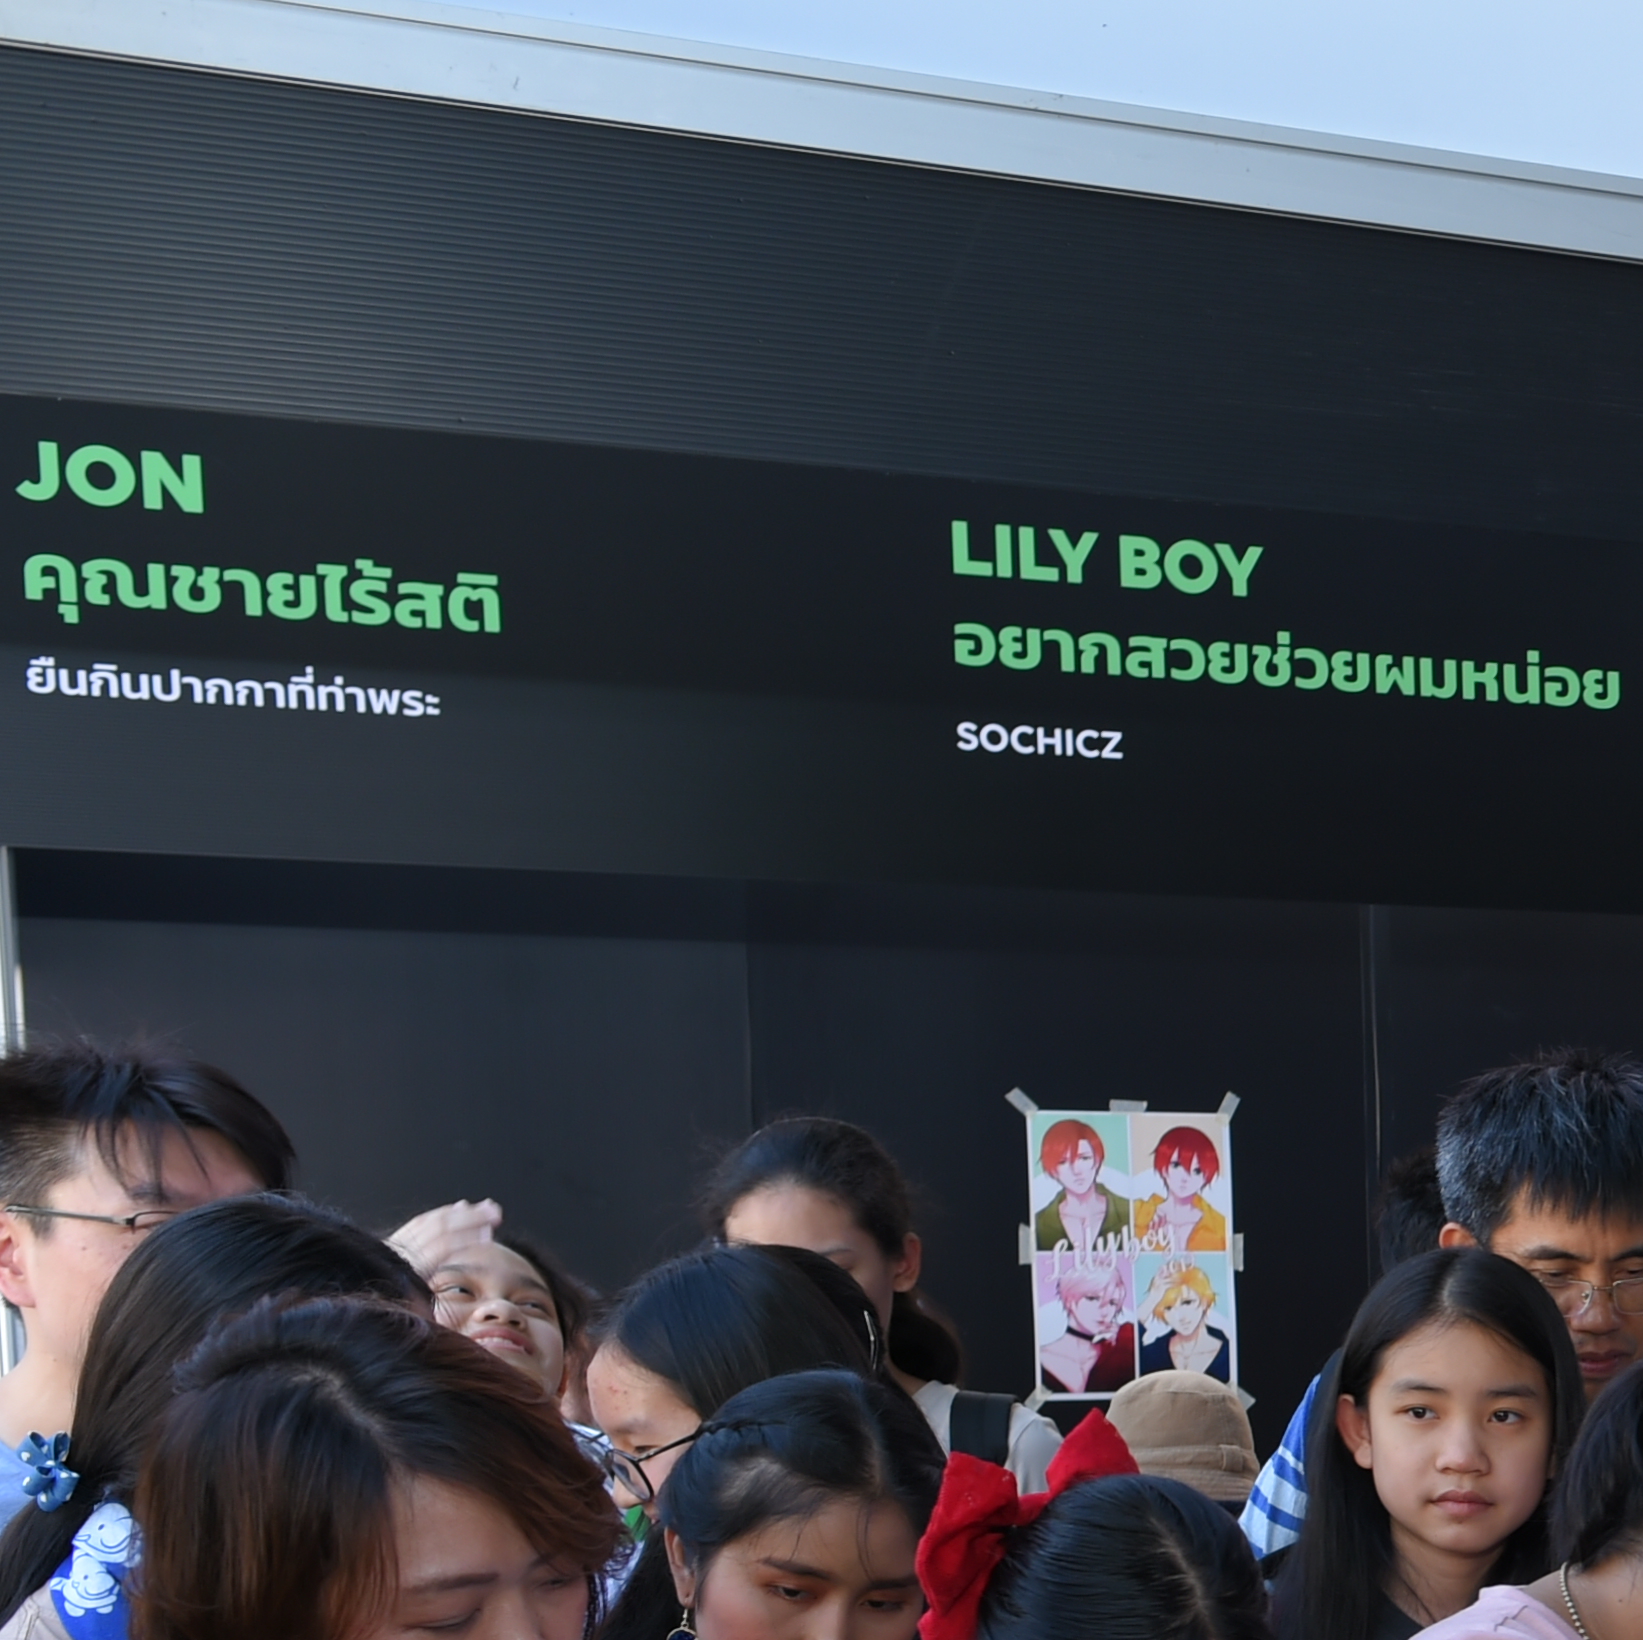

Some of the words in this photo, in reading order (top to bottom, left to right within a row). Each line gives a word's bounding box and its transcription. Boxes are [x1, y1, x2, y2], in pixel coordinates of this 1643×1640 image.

[16, 439, 207, 515] JON
[23, 552, 504, 635] คุณชายไร้สติ
[951, 519, 1100, 585] LILY
[1119, 534, 1264, 598] BOY
[26, 656, 441, 717] ยืนกินปากกาที่ท่าพระ
[953, 621, 1622, 711] อยากสวยช่วยผมหน่อย
[956, 721, 1124, 760] SOCHICZ
